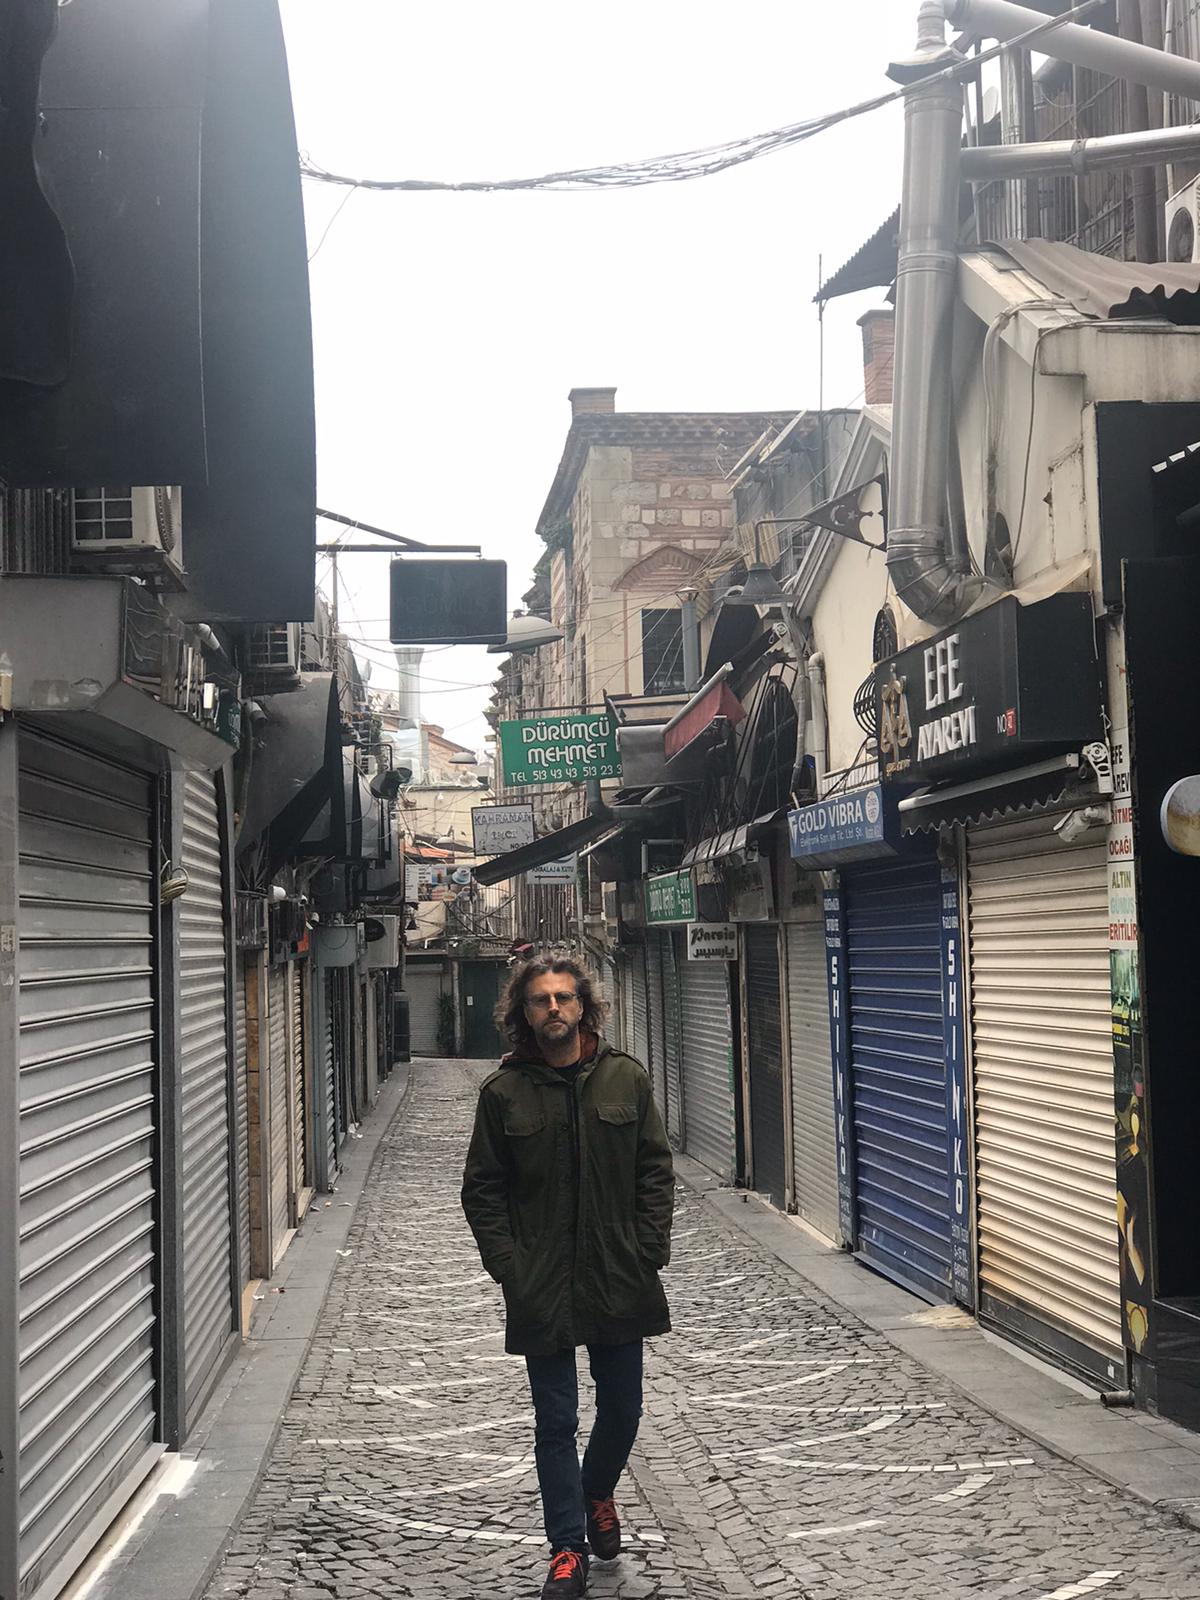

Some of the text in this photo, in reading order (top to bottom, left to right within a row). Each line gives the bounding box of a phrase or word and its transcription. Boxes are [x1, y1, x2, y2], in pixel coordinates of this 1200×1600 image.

[923, 633, 964, 711] EFE
[522, 716, 611, 743] DÜRÜMCÜ
[527, 742, 608, 767] MEHMET
[511, 772, 528, 783] TEL
[532, 769, 548, 781] 513
[550, 769, 563, 780] 43
[565, 767, 578, 778] 43
[583, 766, 597, 777] 513
[600, 764, 614, 776] 23
[798, 808, 827, 834] GOLD
[1109, 835, 1132, 855] OCAĞI
[1112, 871, 1132, 889] ALTIN
